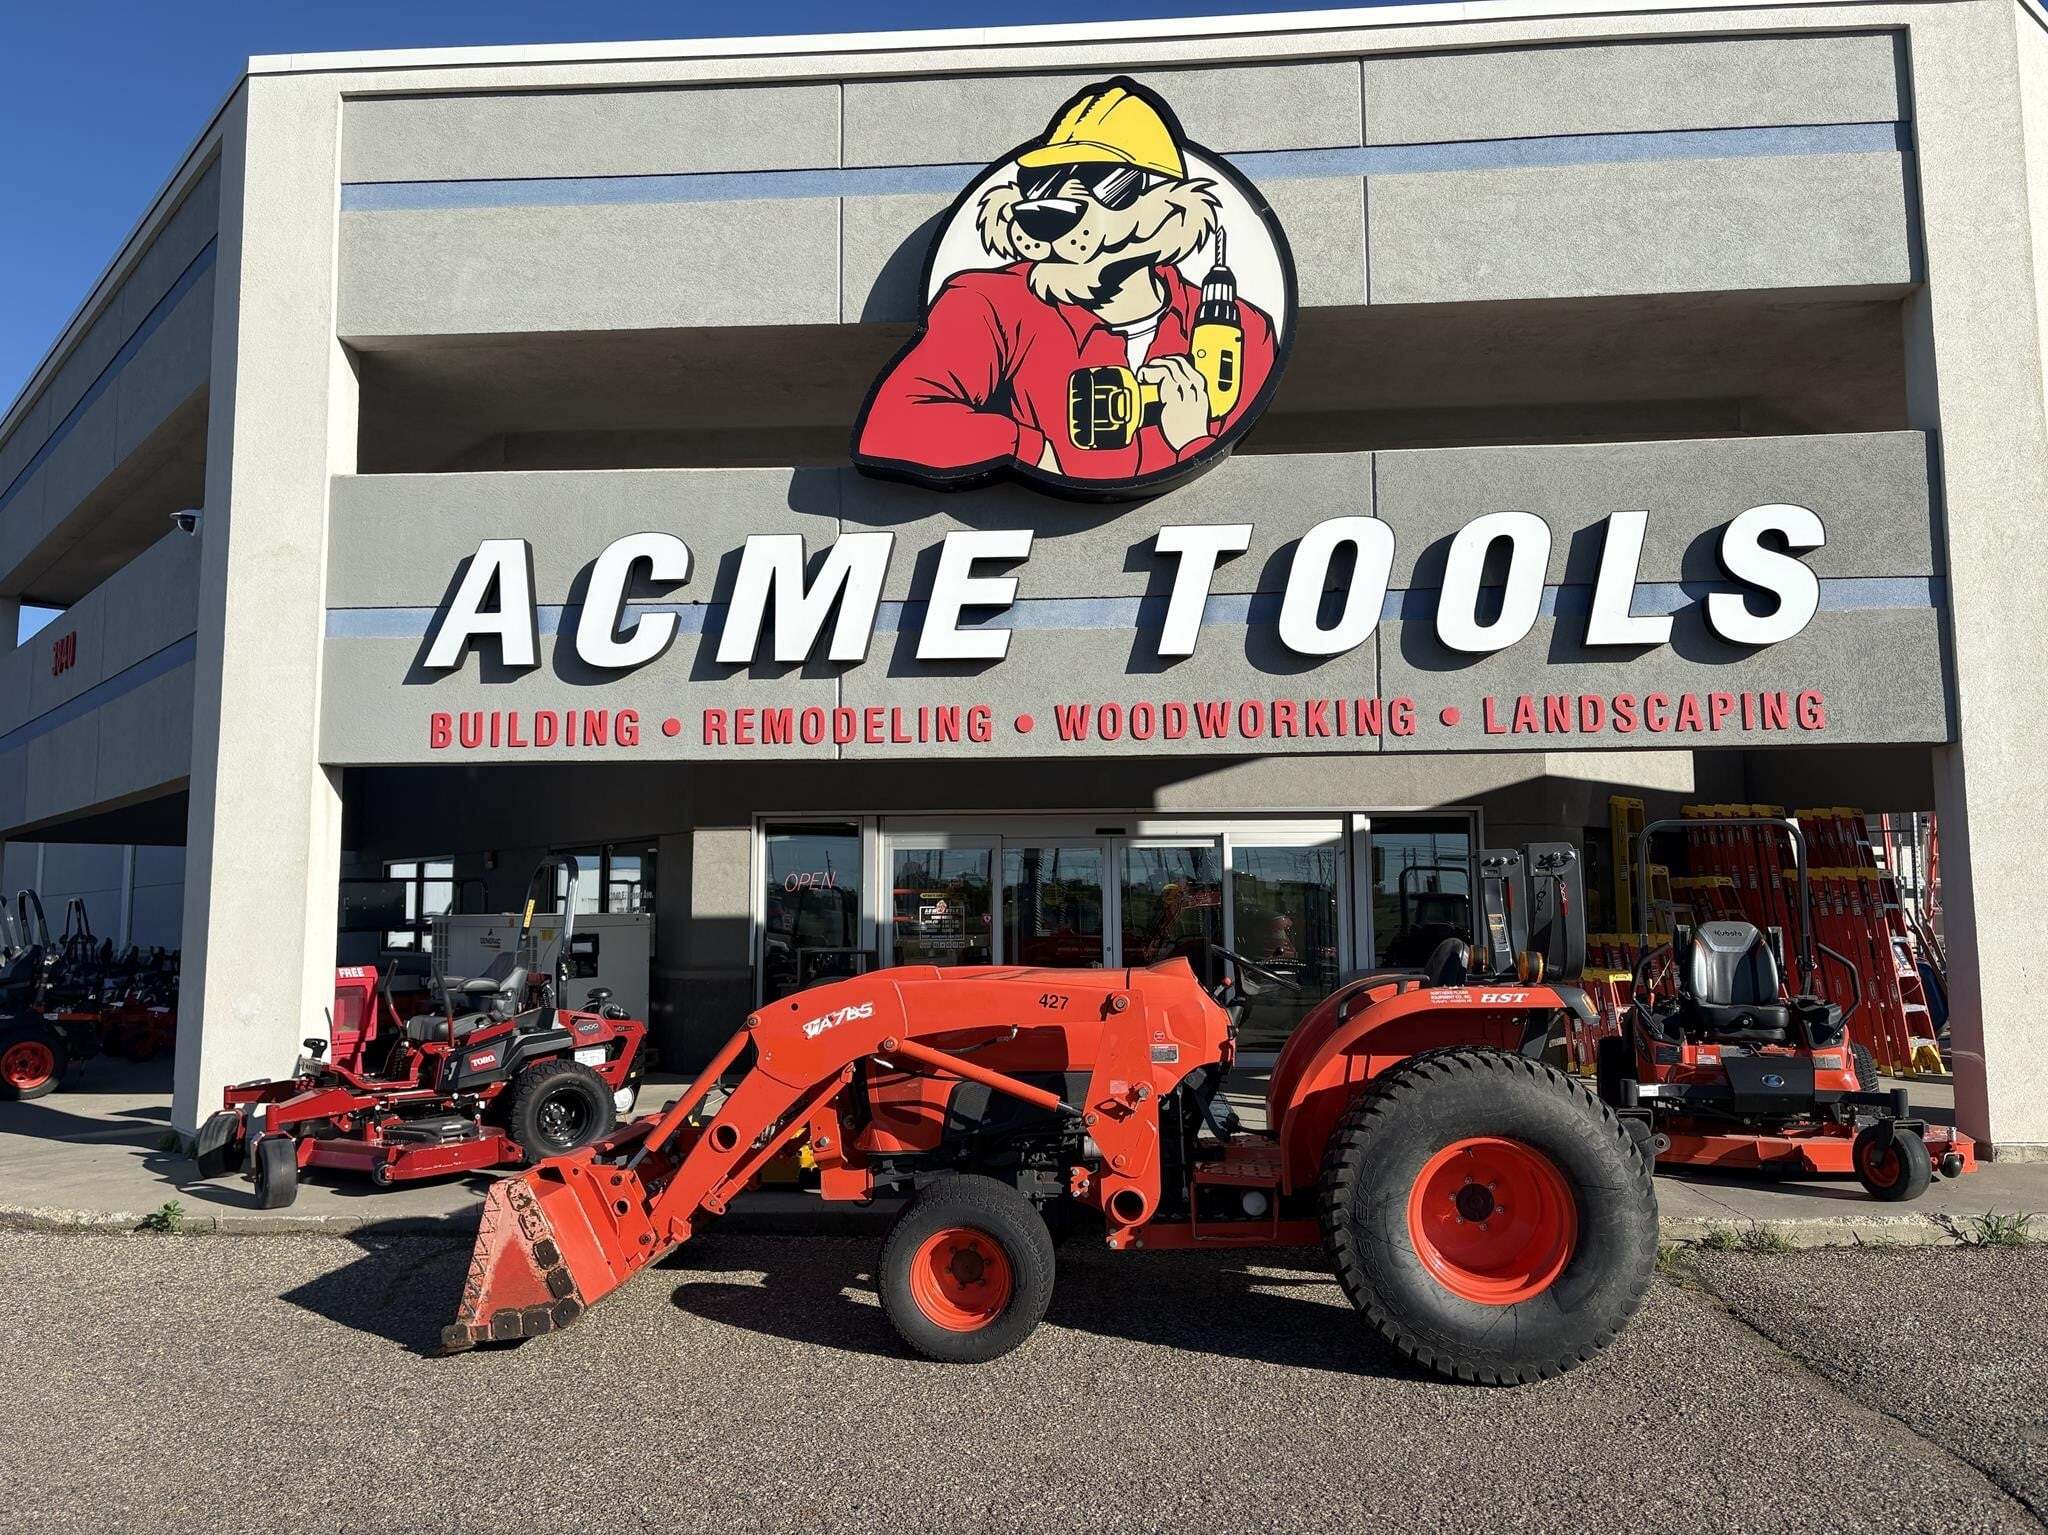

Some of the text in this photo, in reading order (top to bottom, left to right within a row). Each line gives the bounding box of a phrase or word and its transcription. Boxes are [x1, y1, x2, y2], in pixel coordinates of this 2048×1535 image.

[423, 502, 1826, 668] ACME TOOLS
[430, 689, 1827, 749] BUILDING REMODELING WOODWORKING LANDSCAPING
[785, 871, 837, 892] OPEN
[1714, 928, 1743, 937] Kubota
[338, 967, 365, 979] FREE
[1039, 993, 1069, 1010] 427
[1480, 993, 1530, 1004] HST
[472, 1054, 496, 1067] TORO
